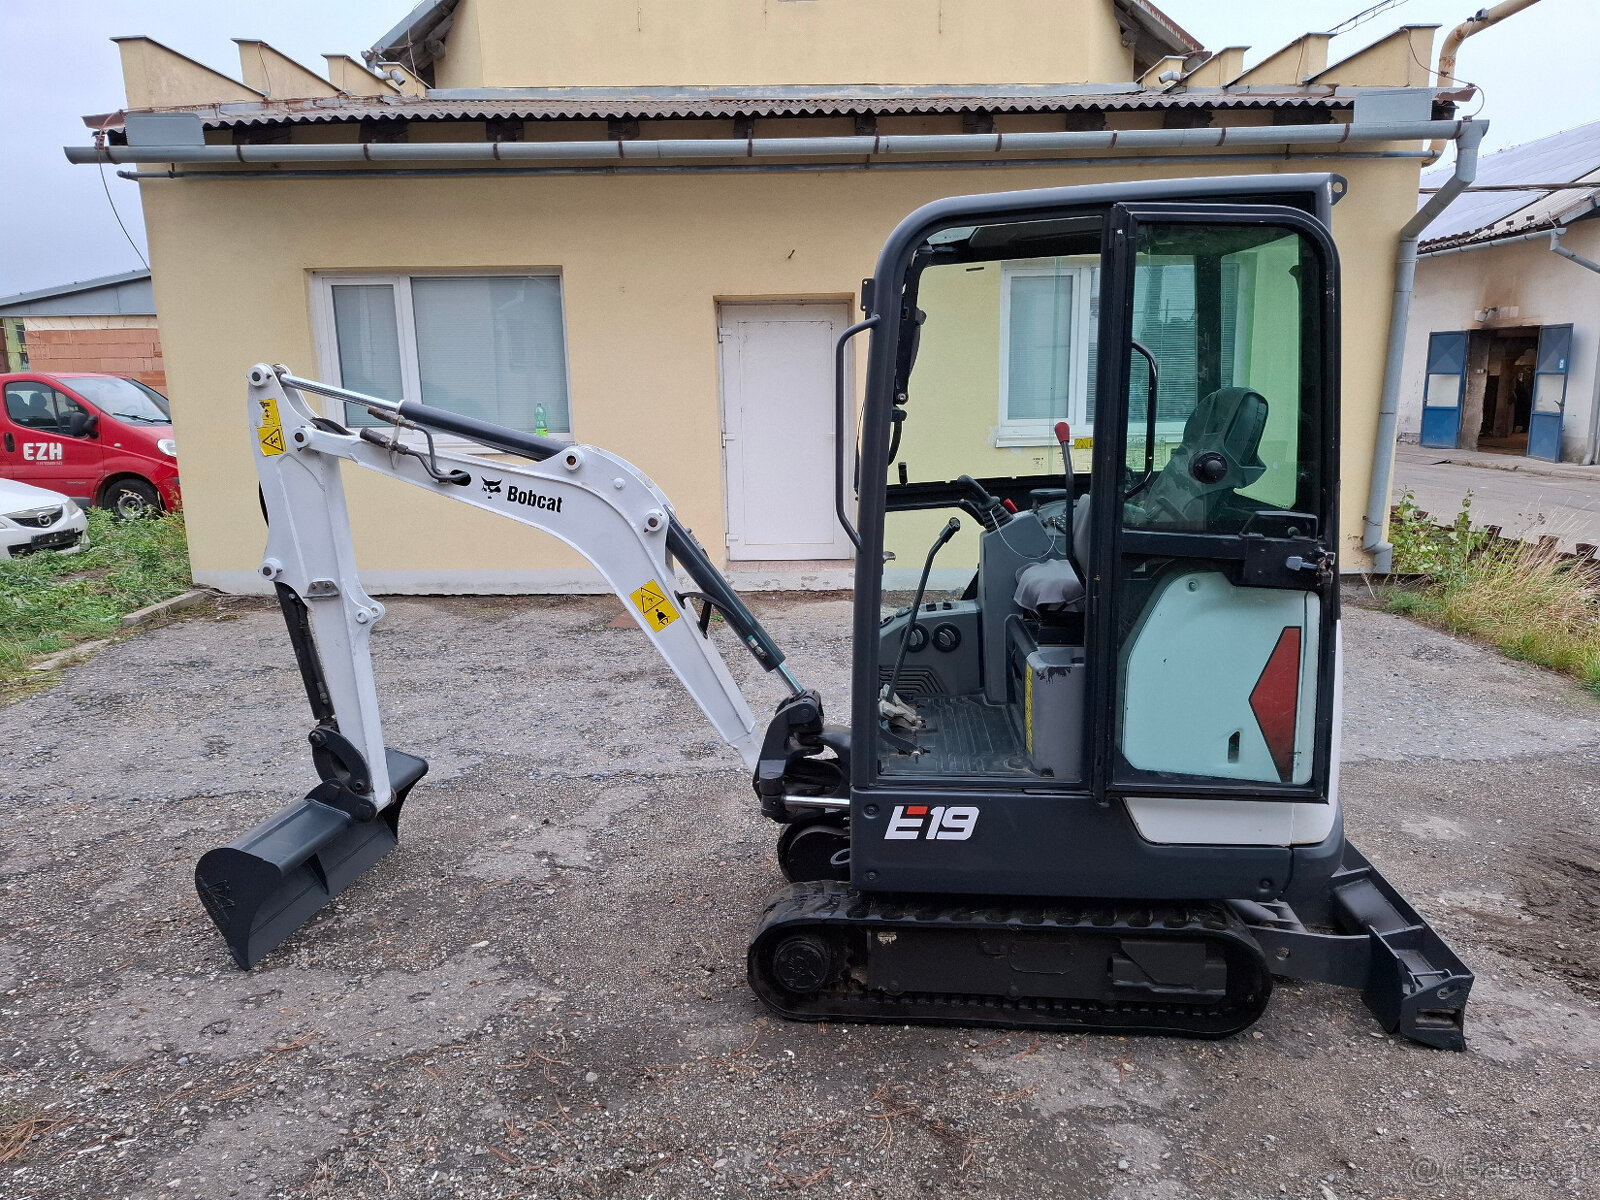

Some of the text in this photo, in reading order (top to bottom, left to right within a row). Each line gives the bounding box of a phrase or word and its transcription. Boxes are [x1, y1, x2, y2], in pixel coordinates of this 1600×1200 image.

[23, 442, 63, 461] EZH
[507, 485, 563, 513] Bobcat
[884, 805, 980, 840] E19
